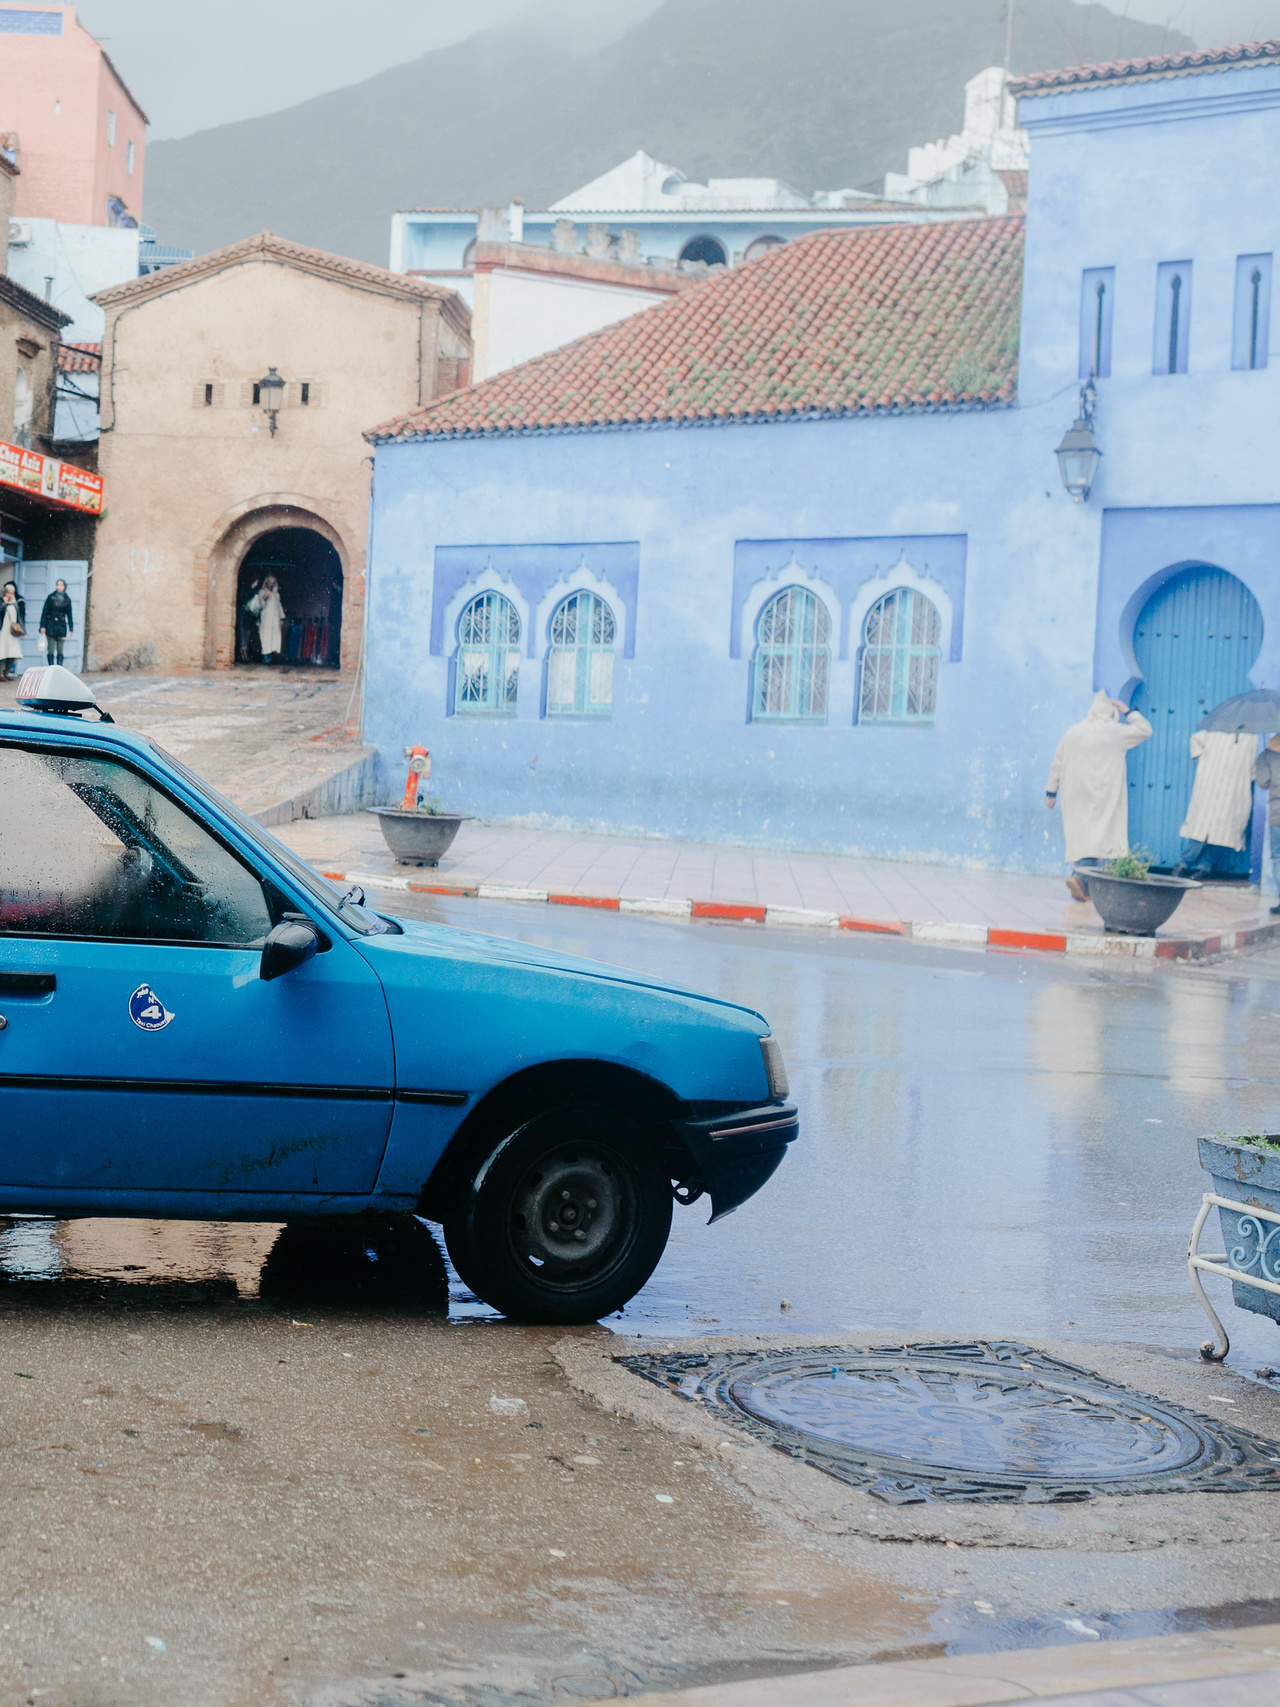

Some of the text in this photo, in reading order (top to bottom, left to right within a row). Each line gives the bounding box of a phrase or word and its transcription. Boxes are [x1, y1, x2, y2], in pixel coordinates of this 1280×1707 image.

[21, 452, 41, 472] Aziz
[61, 466, 101, 491] عند عزيز
[18, 671, 44, 697] TAXI
[140, 1005, 162, 1020] 4
